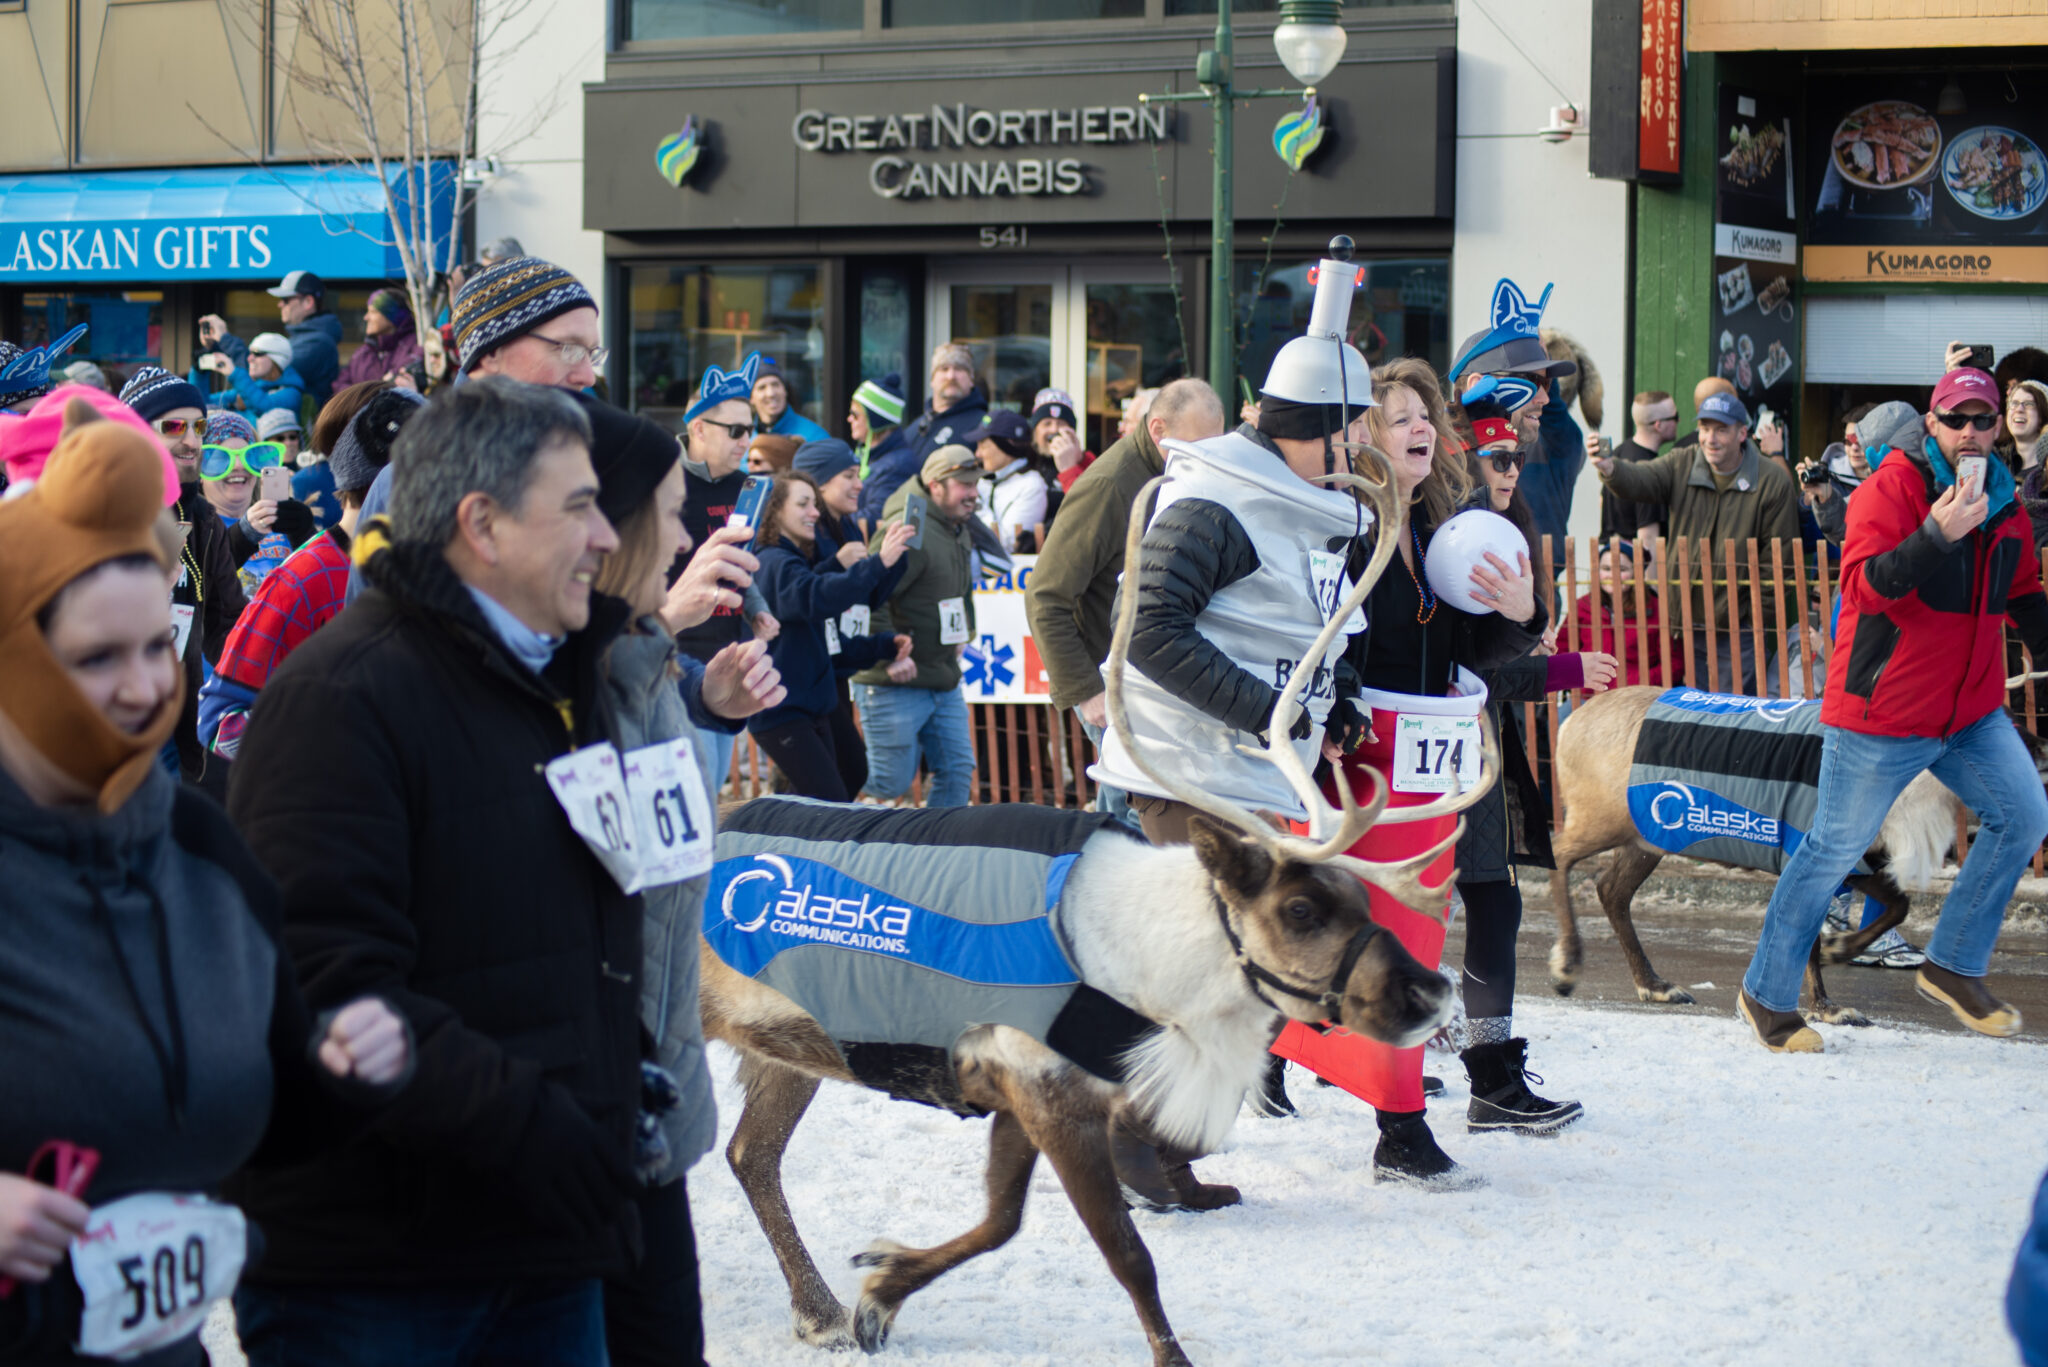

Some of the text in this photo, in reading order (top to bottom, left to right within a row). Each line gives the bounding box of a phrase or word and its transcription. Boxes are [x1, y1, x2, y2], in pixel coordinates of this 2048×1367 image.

[792, 103, 1167, 151] GREAT NORTHERN
[869, 156, 1083, 198] CANNABIS
[154, 225, 272, 269] GIFTS
[979, 227, 1027, 248] 541
[1732, 229, 1782, 254] KUMAGORO
[1867, 250, 1992, 275] KUMAGORO
[1416, 739, 1464, 775] 174
[653, 783, 699, 847] 61
[1687, 804, 1778, 834] alaska
[774, 884, 912, 936] alaska
[117, 1234, 205, 1331] 509
